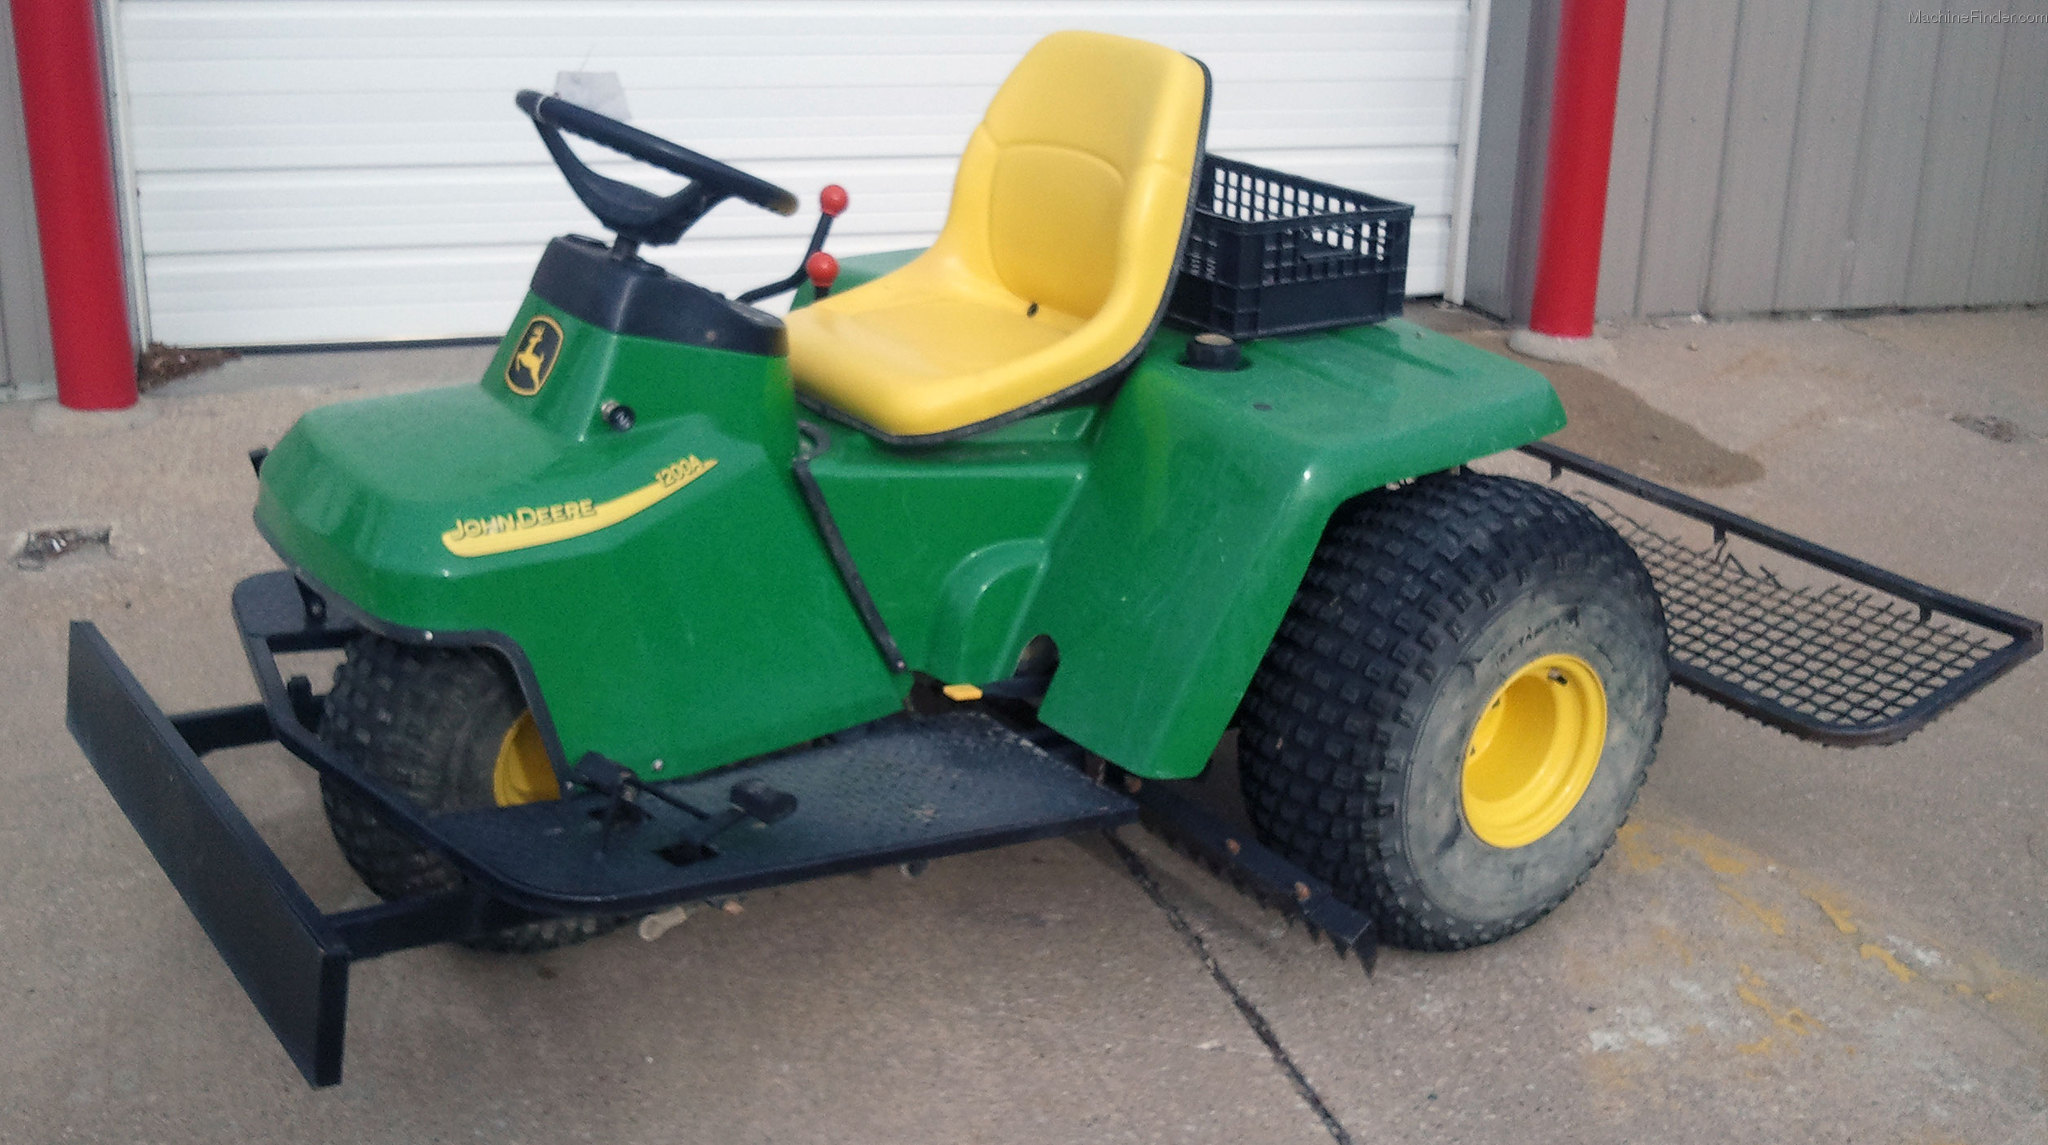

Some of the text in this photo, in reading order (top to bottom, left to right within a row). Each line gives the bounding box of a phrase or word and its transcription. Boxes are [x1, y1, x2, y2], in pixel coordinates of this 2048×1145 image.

[655, 454, 704, 487] 1200A
[449, 499, 597, 541] JOHN DEERE
